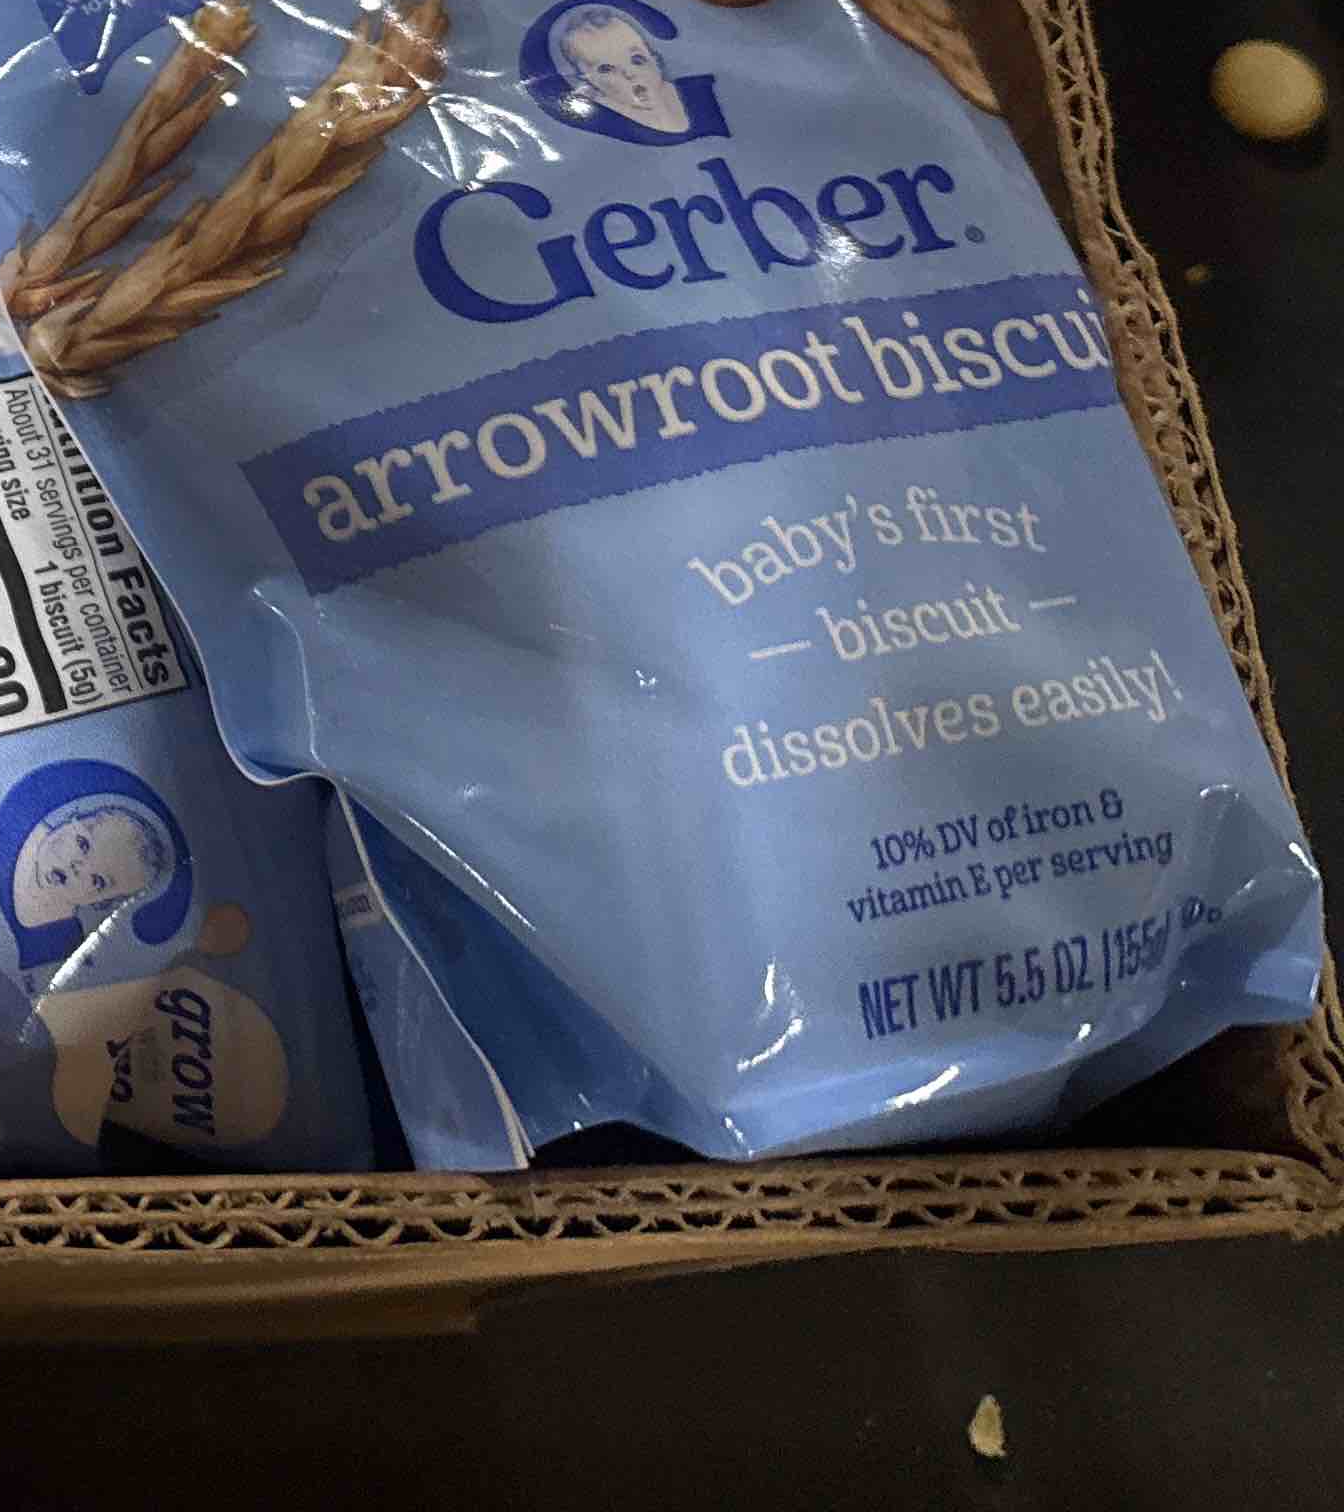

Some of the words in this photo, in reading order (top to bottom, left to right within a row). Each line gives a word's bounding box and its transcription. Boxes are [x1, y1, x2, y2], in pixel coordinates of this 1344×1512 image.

[4, 386, 42, 445] About
[300, 329, 863, 543] arrowroot
[861, 289, 1111, 403] biscui
[0, 476, 36, 521] size
[27, 446, 52, 472] 31
[35, 475, 84, 562] servings
[687, 495, 904, 611] baby's
[904, 482, 1047, 555] first
[33, 561, 55, 576] 1
[66, 563, 96, 598] per
[38, 579, 83, 655] biscuit
[81, 599, 133, 697] container
[106, 562, 175, 688] Facts
[816, 583, 1023, 664] biscuit
[61, 655, 103, 706] (5g)
[719, 686, 1002, 789] dissolves
[1009, 650, 1185, 733] easily!
[867, 830, 938, 870] 10%
[939, 817, 980, 861] DV
[985, 808, 1022, 848] of
[1022, 798, 1095, 837] iron
[1098, 789, 1126, 823] &
[846, 873, 968, 925] vitamin
[969, 867, 992, 900] E
[992, 856, 1045, 901] per
[1049, 829, 1176, 889] serving
[856, 973, 920, 1042] NET
[927, 959, 984, 1020] WT
[992, 946, 1049, 1007] 5.5
[1051, 934, 1097, 992] OZ
[154, 986, 218, 1137] grow
